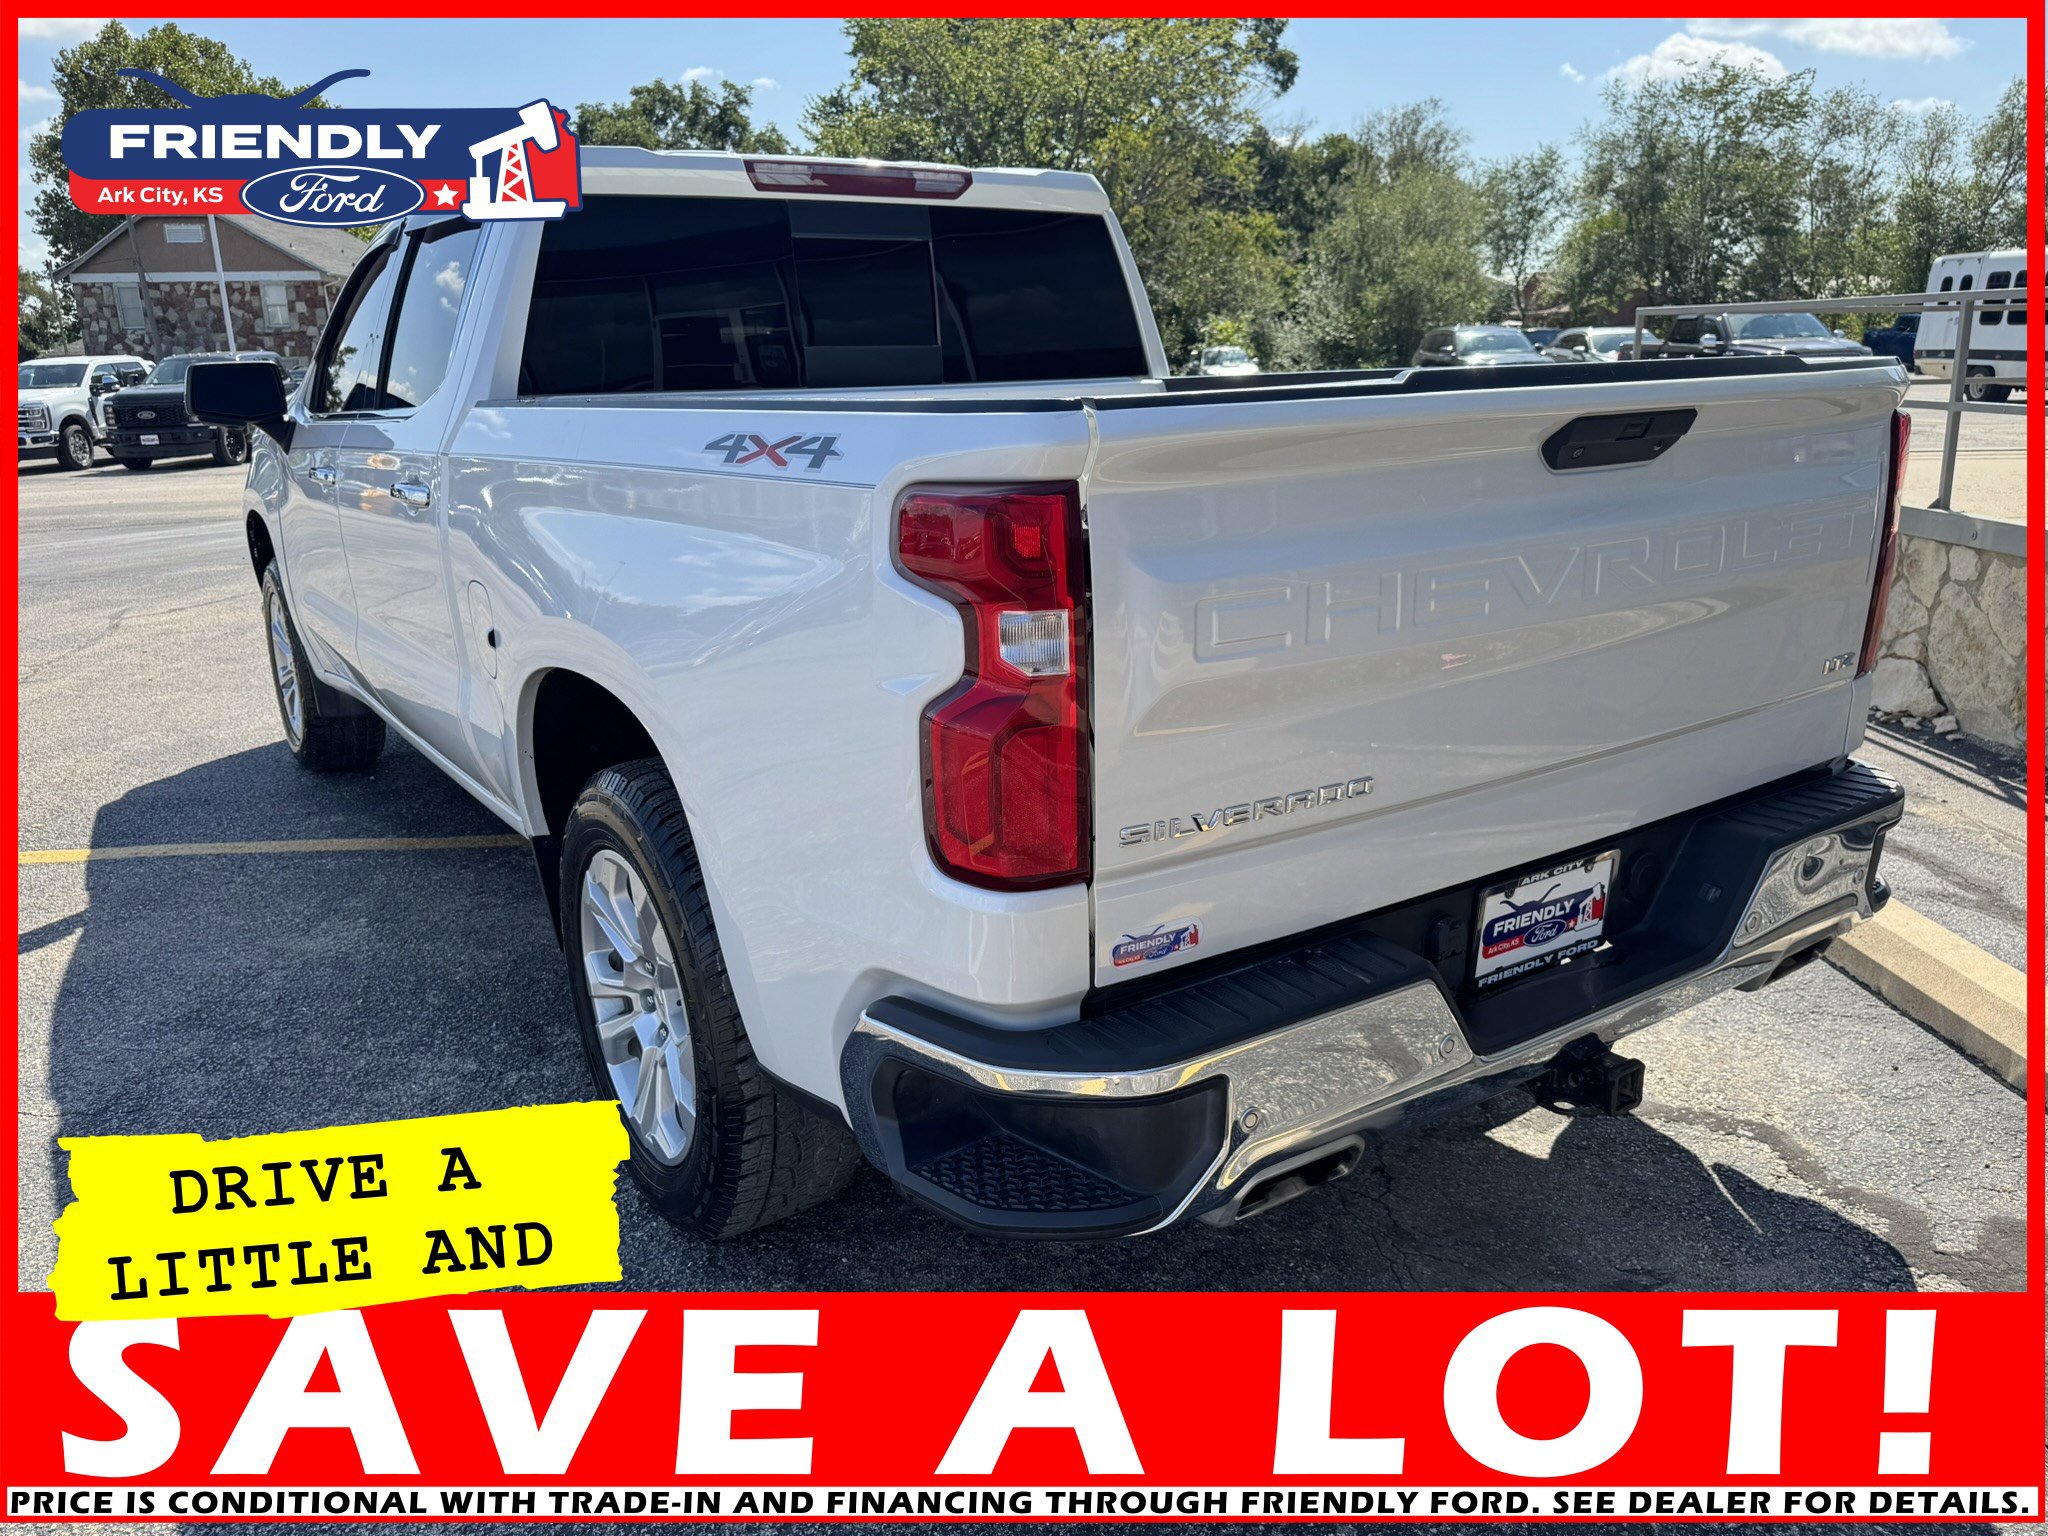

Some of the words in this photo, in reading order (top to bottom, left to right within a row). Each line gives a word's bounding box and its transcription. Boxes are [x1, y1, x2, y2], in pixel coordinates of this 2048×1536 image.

[1194, 499, 1872, 663] CHEVROLET
[1119, 776, 1375, 848] SILVERADO
[1521, 871, 1550, 886] ARK
[1553, 860, 1584, 876] CITY
[1493, 898, 1575, 937] FRIENDLY
[1531, 923, 1558, 943] Ford
[1120, 932, 1177, 955] FRIENDLY
[1478, 953, 1554, 988] FRIENDLY
[1557, 939, 1599, 960] FORD
